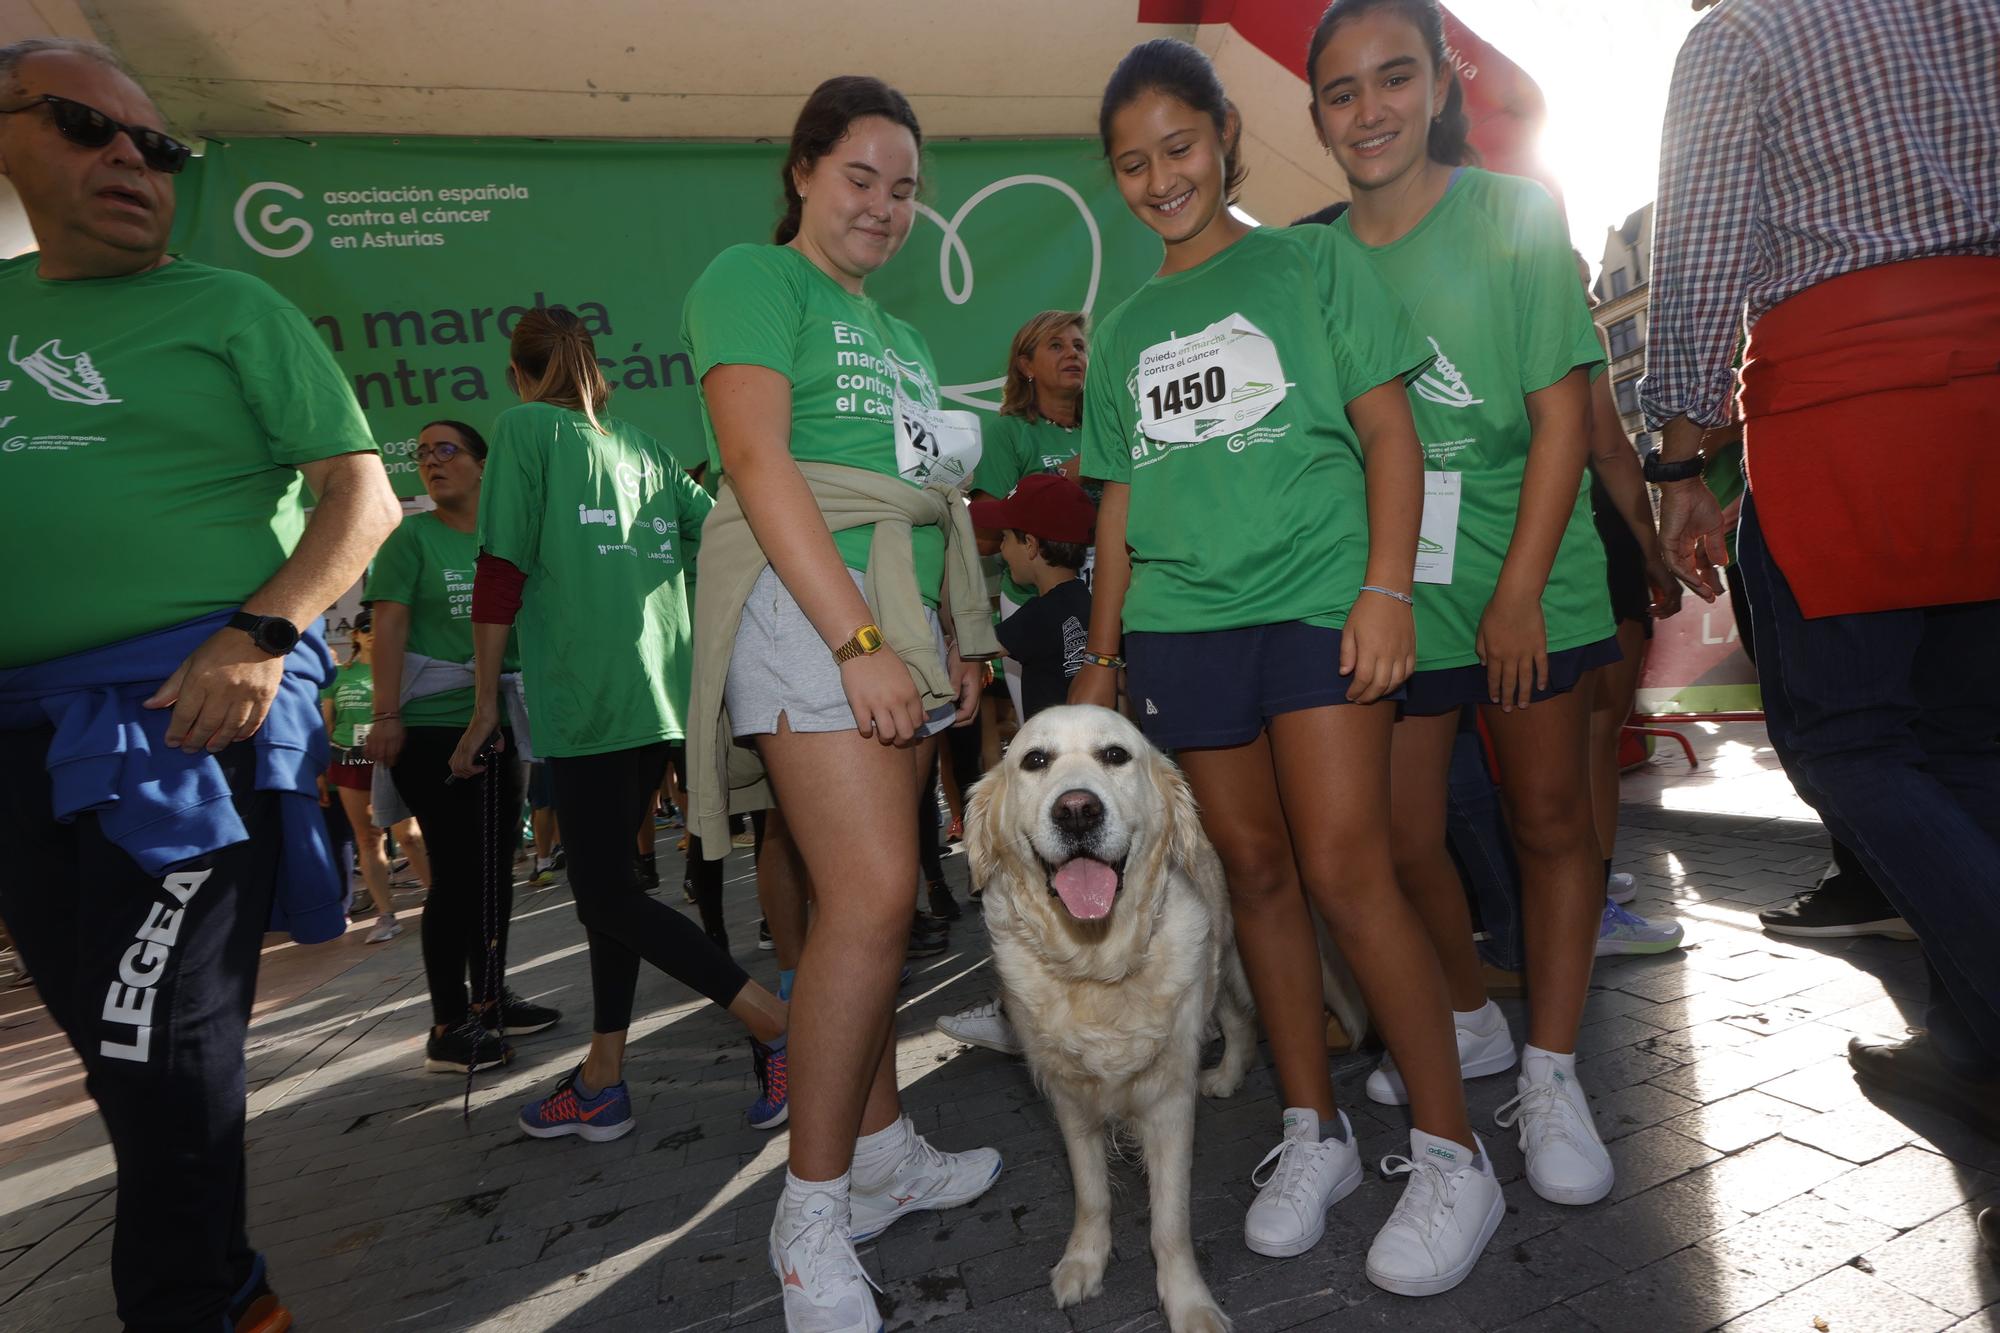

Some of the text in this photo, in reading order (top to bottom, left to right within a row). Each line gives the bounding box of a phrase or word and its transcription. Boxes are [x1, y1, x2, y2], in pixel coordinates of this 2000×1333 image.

[323, 183, 529, 205] asociación española
[327, 207, 491, 226] contra el cáncer
[330, 231, 445, 249] en Asturias
[363, 291, 613, 350] marca
[833, 325, 864, 346] En
[1144, 350, 1177, 365] Oviedo
[1191, 333, 1226, 353] marcha
[1144, 347, 1220, 377] contra el cáncer
[354, 342, 697, 411] ntra cán
[836, 392, 857, 413] el
[1146, 366, 1226, 420] 1450
[443, 571, 463, 581] En
[100, 867, 213, 1063] LEGEA
[1428, 1147, 1455, 1160] adidas
